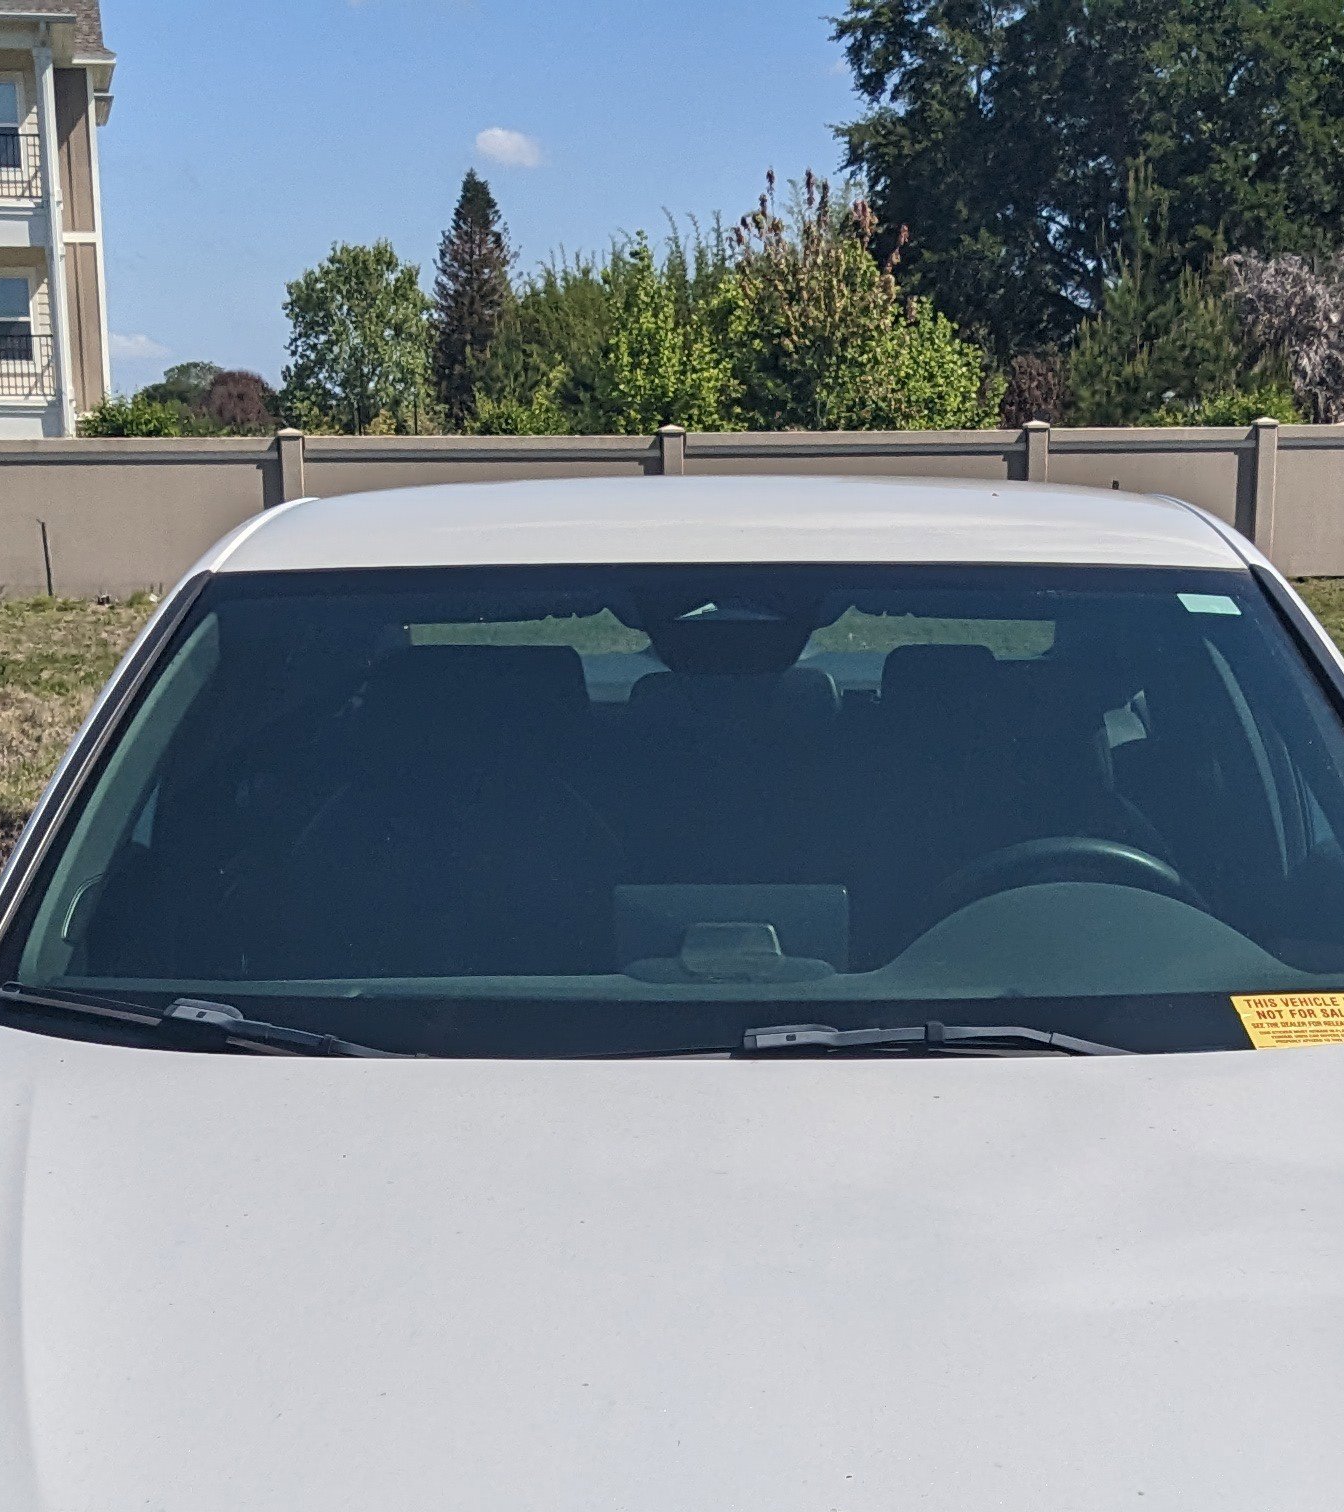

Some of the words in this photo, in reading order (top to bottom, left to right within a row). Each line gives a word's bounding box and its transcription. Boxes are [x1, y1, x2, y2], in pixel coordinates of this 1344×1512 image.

[1243, 997, 1278, 1009] THIS
[1280, 996, 1340, 1007] VEHICLE
[1256, 1009, 1284, 1020] NOT
[1289, 1008, 1316, 1019] FOR
